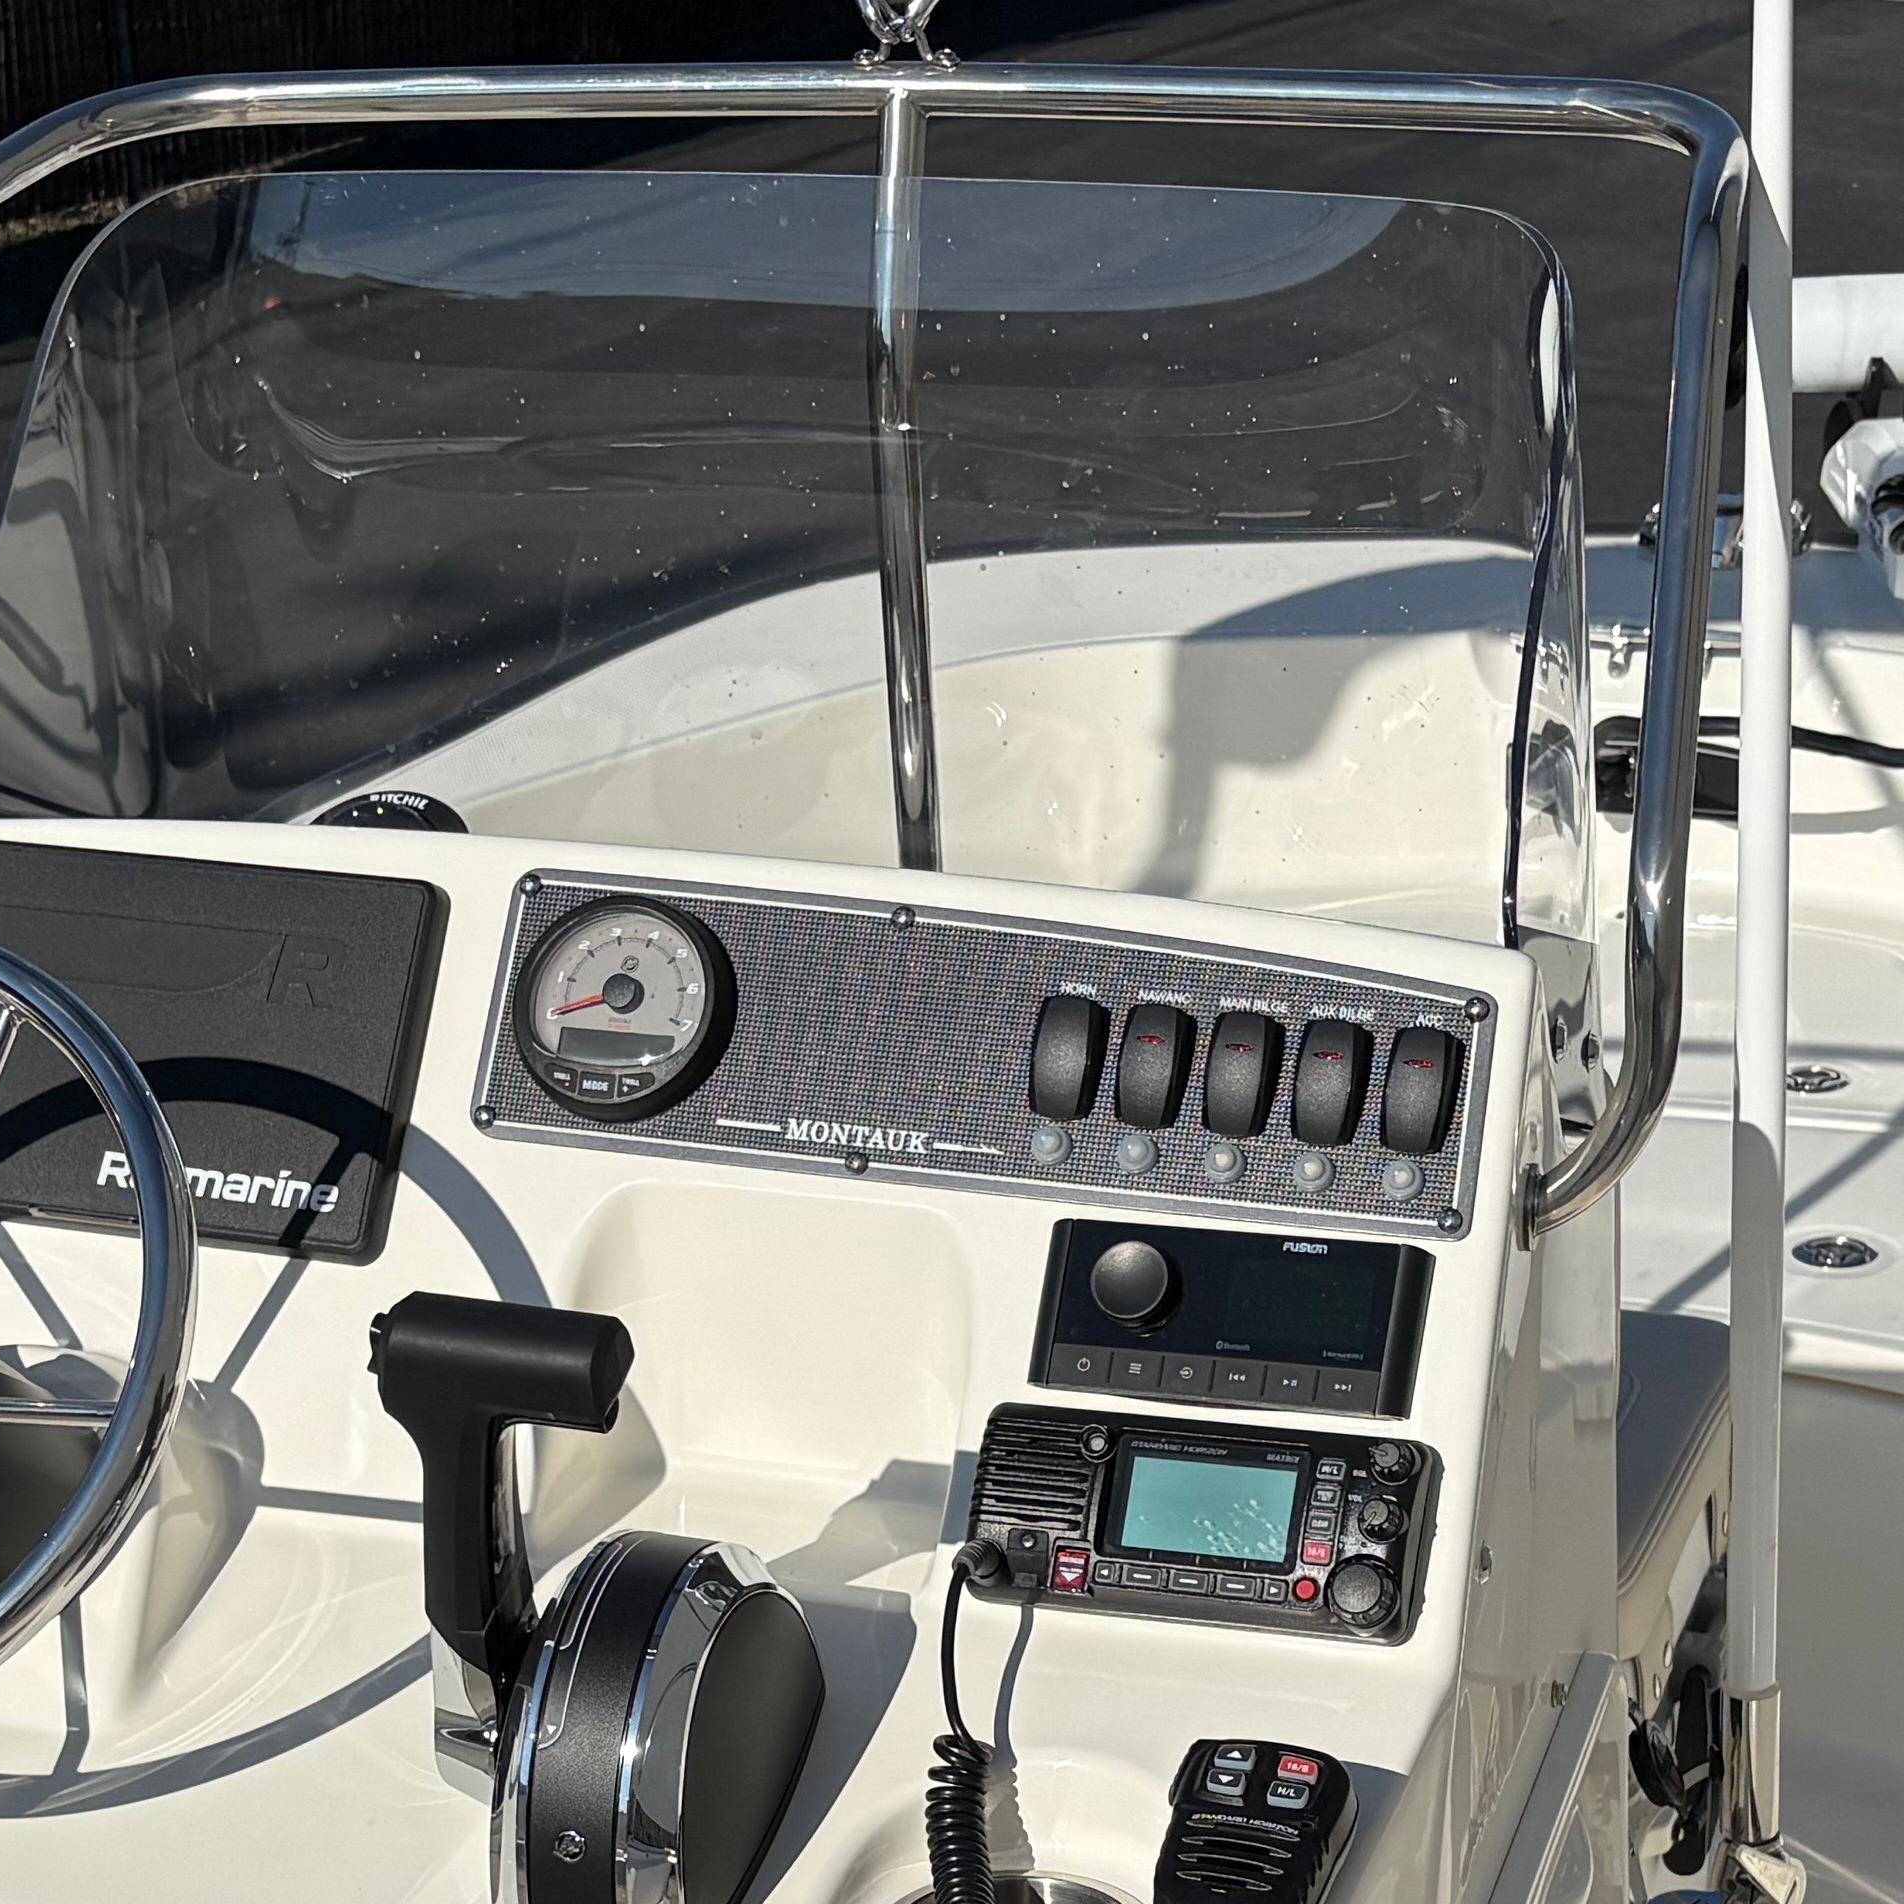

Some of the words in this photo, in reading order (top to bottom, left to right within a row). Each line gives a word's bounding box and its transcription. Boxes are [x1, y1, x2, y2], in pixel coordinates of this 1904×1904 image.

[609, 927, 623, 937] 3
[646, 931, 660, 940] 4
[578, 940, 591, 950] 2
[674, 948, 688, 959] 5
[558, 970, 565, 983] 1
[686, 982, 700, 994] 6
[1060, 981, 1096, 999] HORN
[1218, 997, 1251, 1013] MAIN
[1252, 1000, 1289, 1014] BILGE
[1309, 1004, 1336, 1020] AUX
[1338, 1007, 1375, 1022] BILGE
[678, 1019, 694, 1032] 7
[582, 1079, 610, 1092] MODE
[784, 1117, 929, 1153] MONTAUK
[96, 1150, 340, 1214] Rmarine
[1277, 1785, 1296, 1797] H/L
